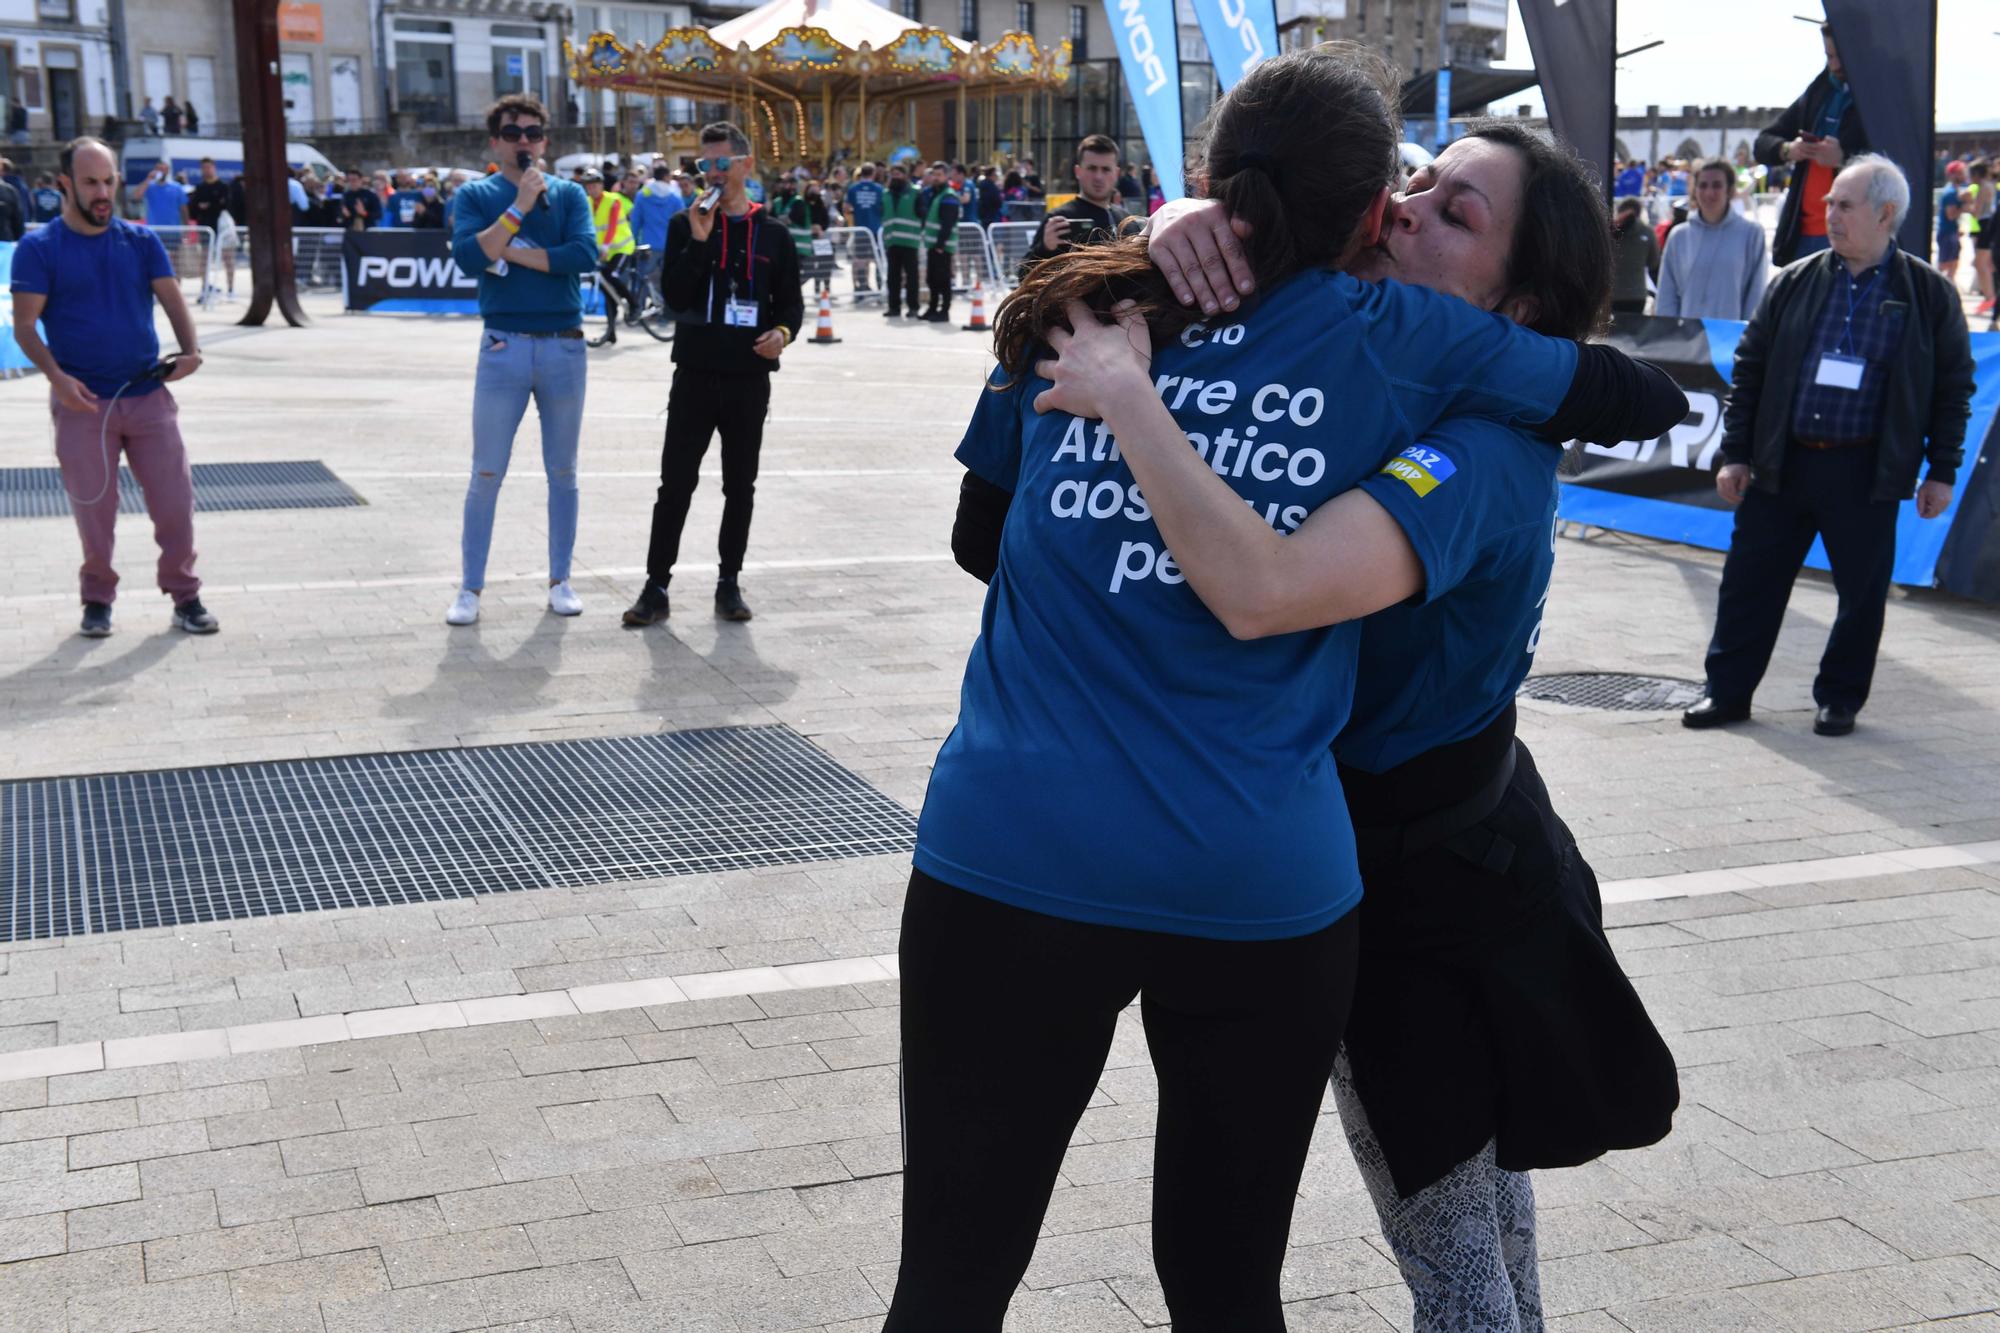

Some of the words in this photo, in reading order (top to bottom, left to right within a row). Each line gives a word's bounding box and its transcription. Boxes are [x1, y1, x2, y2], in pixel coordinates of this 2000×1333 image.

[1154, 373, 1238, 415] rre
[1251, 383, 1325, 427] co
[1400, 446, 1441, 469] PAZ
[1050, 479, 1153, 522] aos
[1108, 540, 1187, 593] pe
